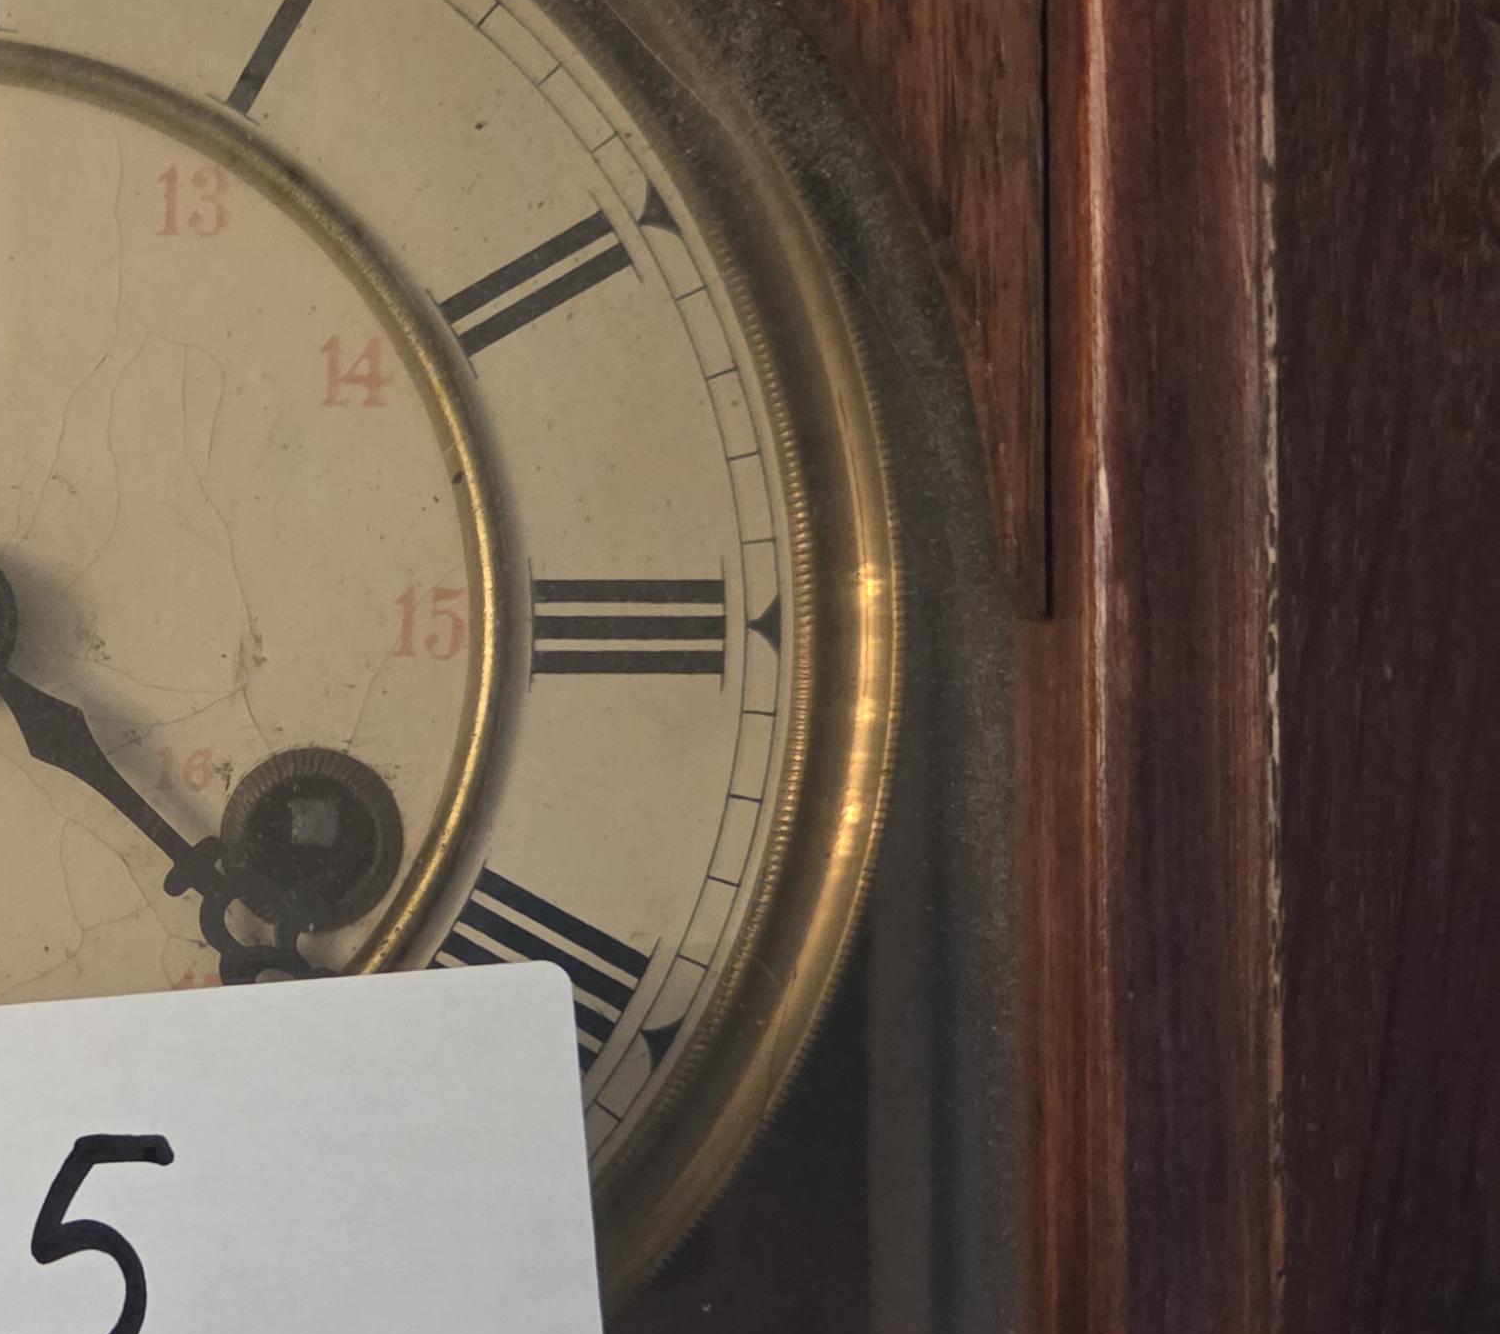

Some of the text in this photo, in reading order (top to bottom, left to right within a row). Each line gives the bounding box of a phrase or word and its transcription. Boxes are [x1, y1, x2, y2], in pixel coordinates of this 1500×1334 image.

[156, 166, 230, 237] 13
[426, 189, 643, 379] II
[320, 334, 392, 408] 14
[394, 584, 468, 662] 15
[528, 556, 725, 692] III
[156, 746, 213, 793] 16
